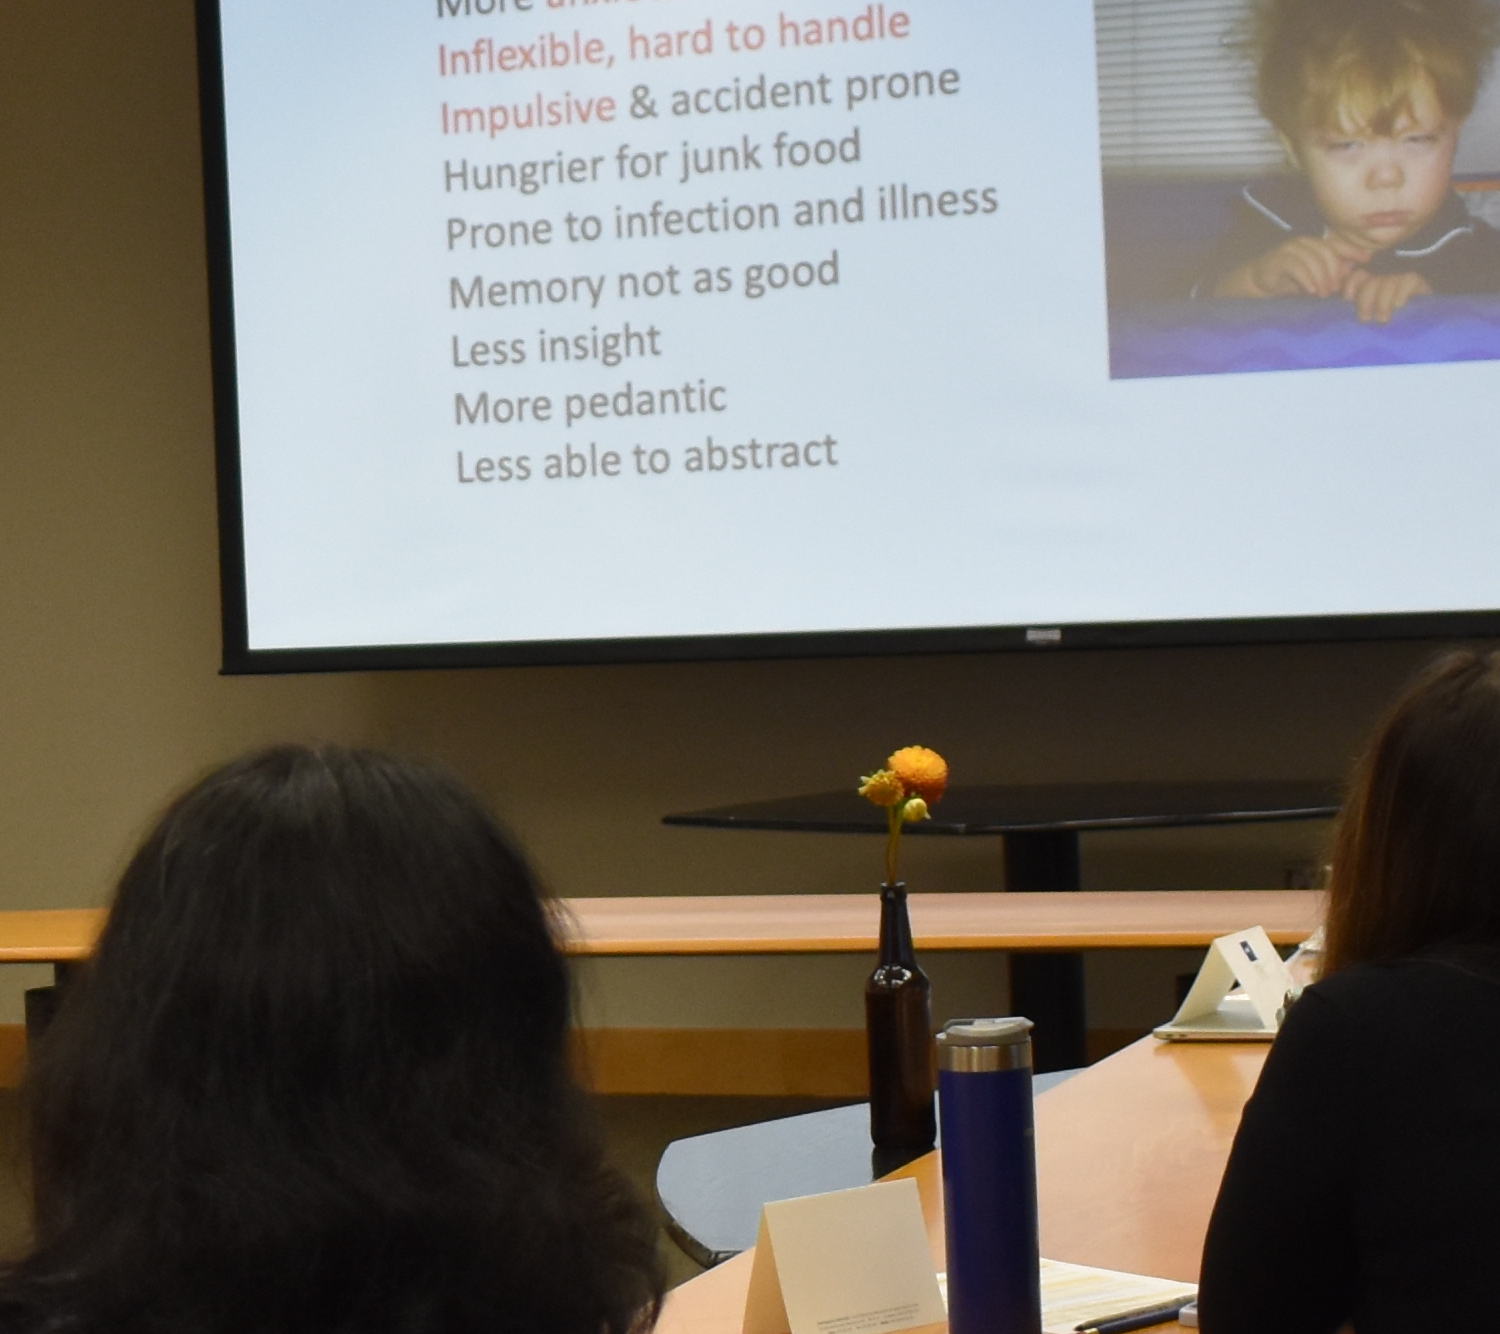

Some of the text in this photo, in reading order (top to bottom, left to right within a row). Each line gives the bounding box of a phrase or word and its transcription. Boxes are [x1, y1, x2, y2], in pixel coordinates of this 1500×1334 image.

[438, 4, 910, 77] Inflexible, hard to handle
[441, 67, 962, 140] Impulsive & accident prone
[443, 125, 862, 197] Hungrier for junk food
[445, 181, 1000, 252] Prone to infection and illness
[448, 248, 841, 311] Memory not as good
[451, 321, 663, 369] Less insight
[453, 380, 728, 430] More pedantic
[456, 433, 840, 485] Less able to abstract
